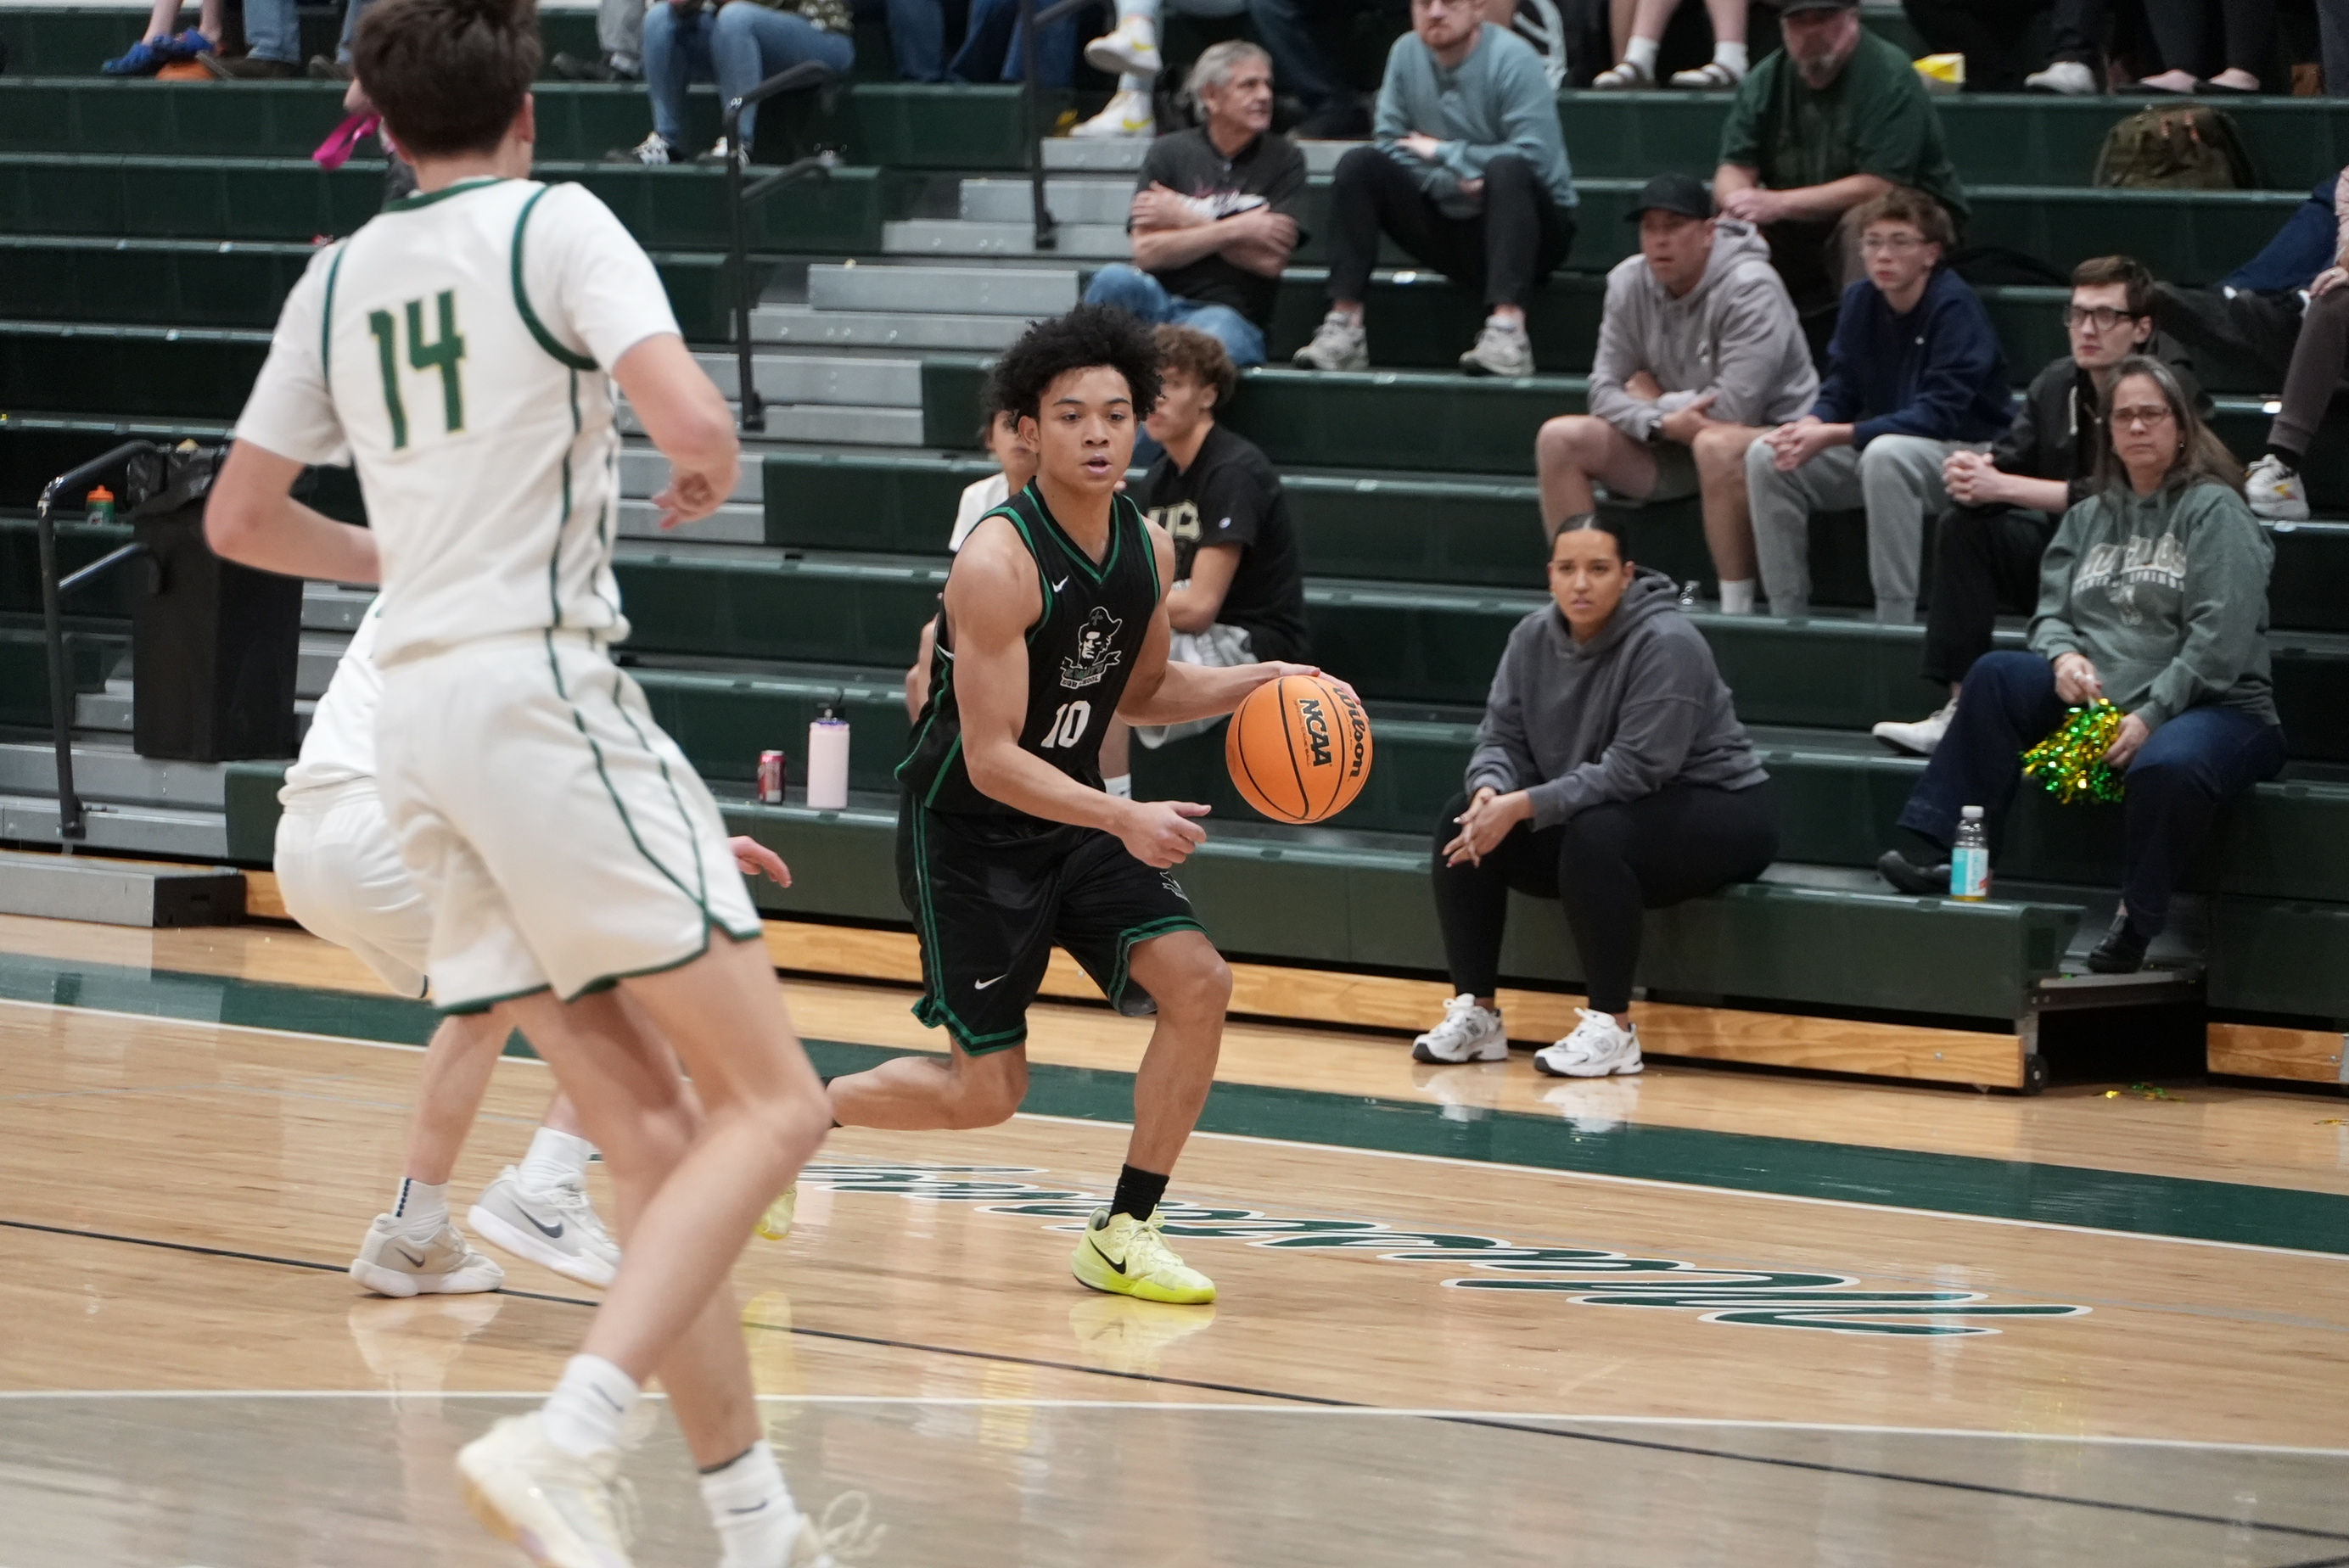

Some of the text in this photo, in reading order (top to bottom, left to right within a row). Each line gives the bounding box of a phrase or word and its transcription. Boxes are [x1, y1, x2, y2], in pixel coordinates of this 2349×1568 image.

[367, 288, 468, 451] 14
[1040, 700, 1091, 748] 10
[1298, 698, 1332, 768] NCAA
[1332, 686, 1365, 778] Wilson
[587, 1152, 2094, 1337] Mustang
